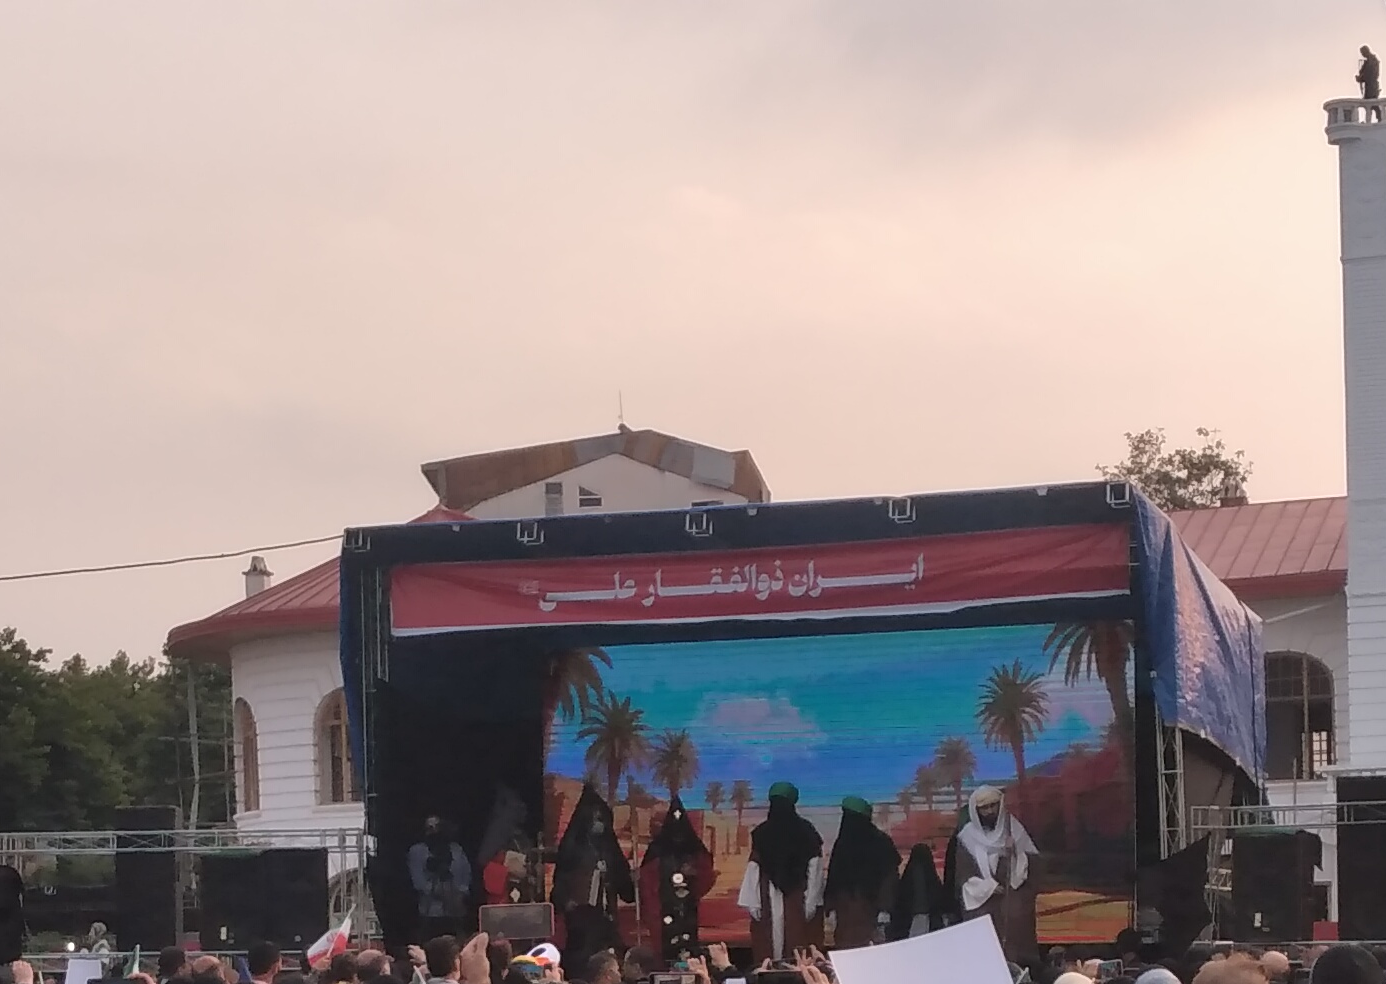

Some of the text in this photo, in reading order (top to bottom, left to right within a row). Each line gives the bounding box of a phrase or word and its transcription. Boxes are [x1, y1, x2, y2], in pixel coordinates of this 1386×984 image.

[540, 553, 923, 611] ایران ذوالفقار علی
